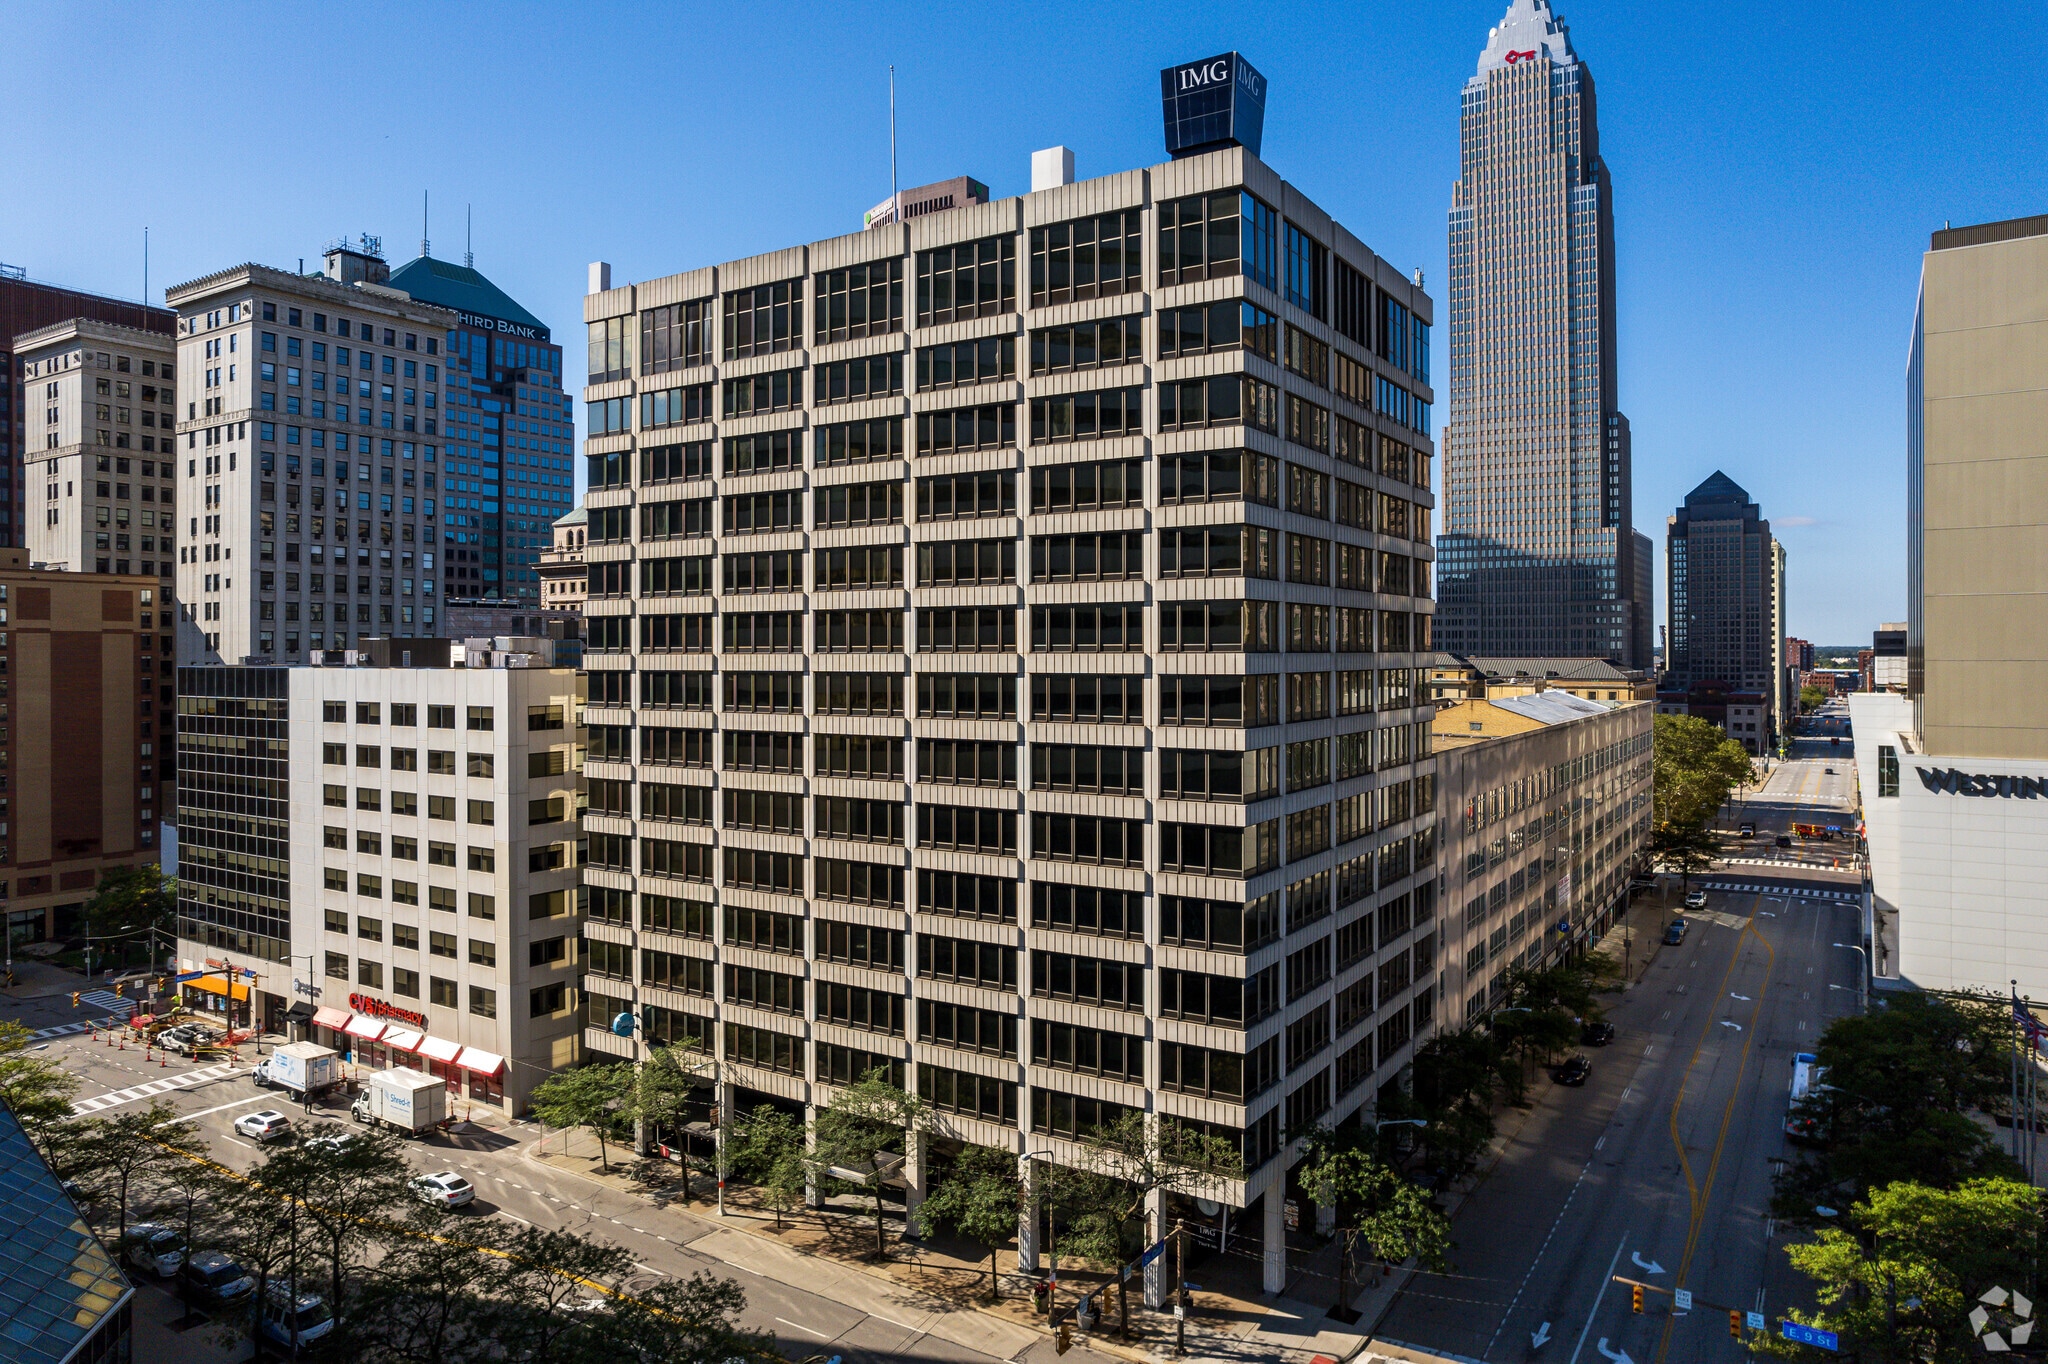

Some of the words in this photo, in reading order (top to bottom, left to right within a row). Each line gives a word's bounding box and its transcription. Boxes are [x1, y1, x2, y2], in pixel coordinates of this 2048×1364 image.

[1180, 60, 1228, 90] IMG
[1238, 62, 1260, 96] IMG
[457, 311, 494, 330] HIRD
[497, 319, 535, 340] BANK
[1914, 766, 2045, 796] WESTIN
[390, 1093, 411, 1108] Shred-it
[1199, 1226, 1216, 1237] IMG
[1789, 1328, 1799, 1339] E.
[1804, 1332, 1813, 1342] 9
[1817, 1336, 1831, 1347] St
